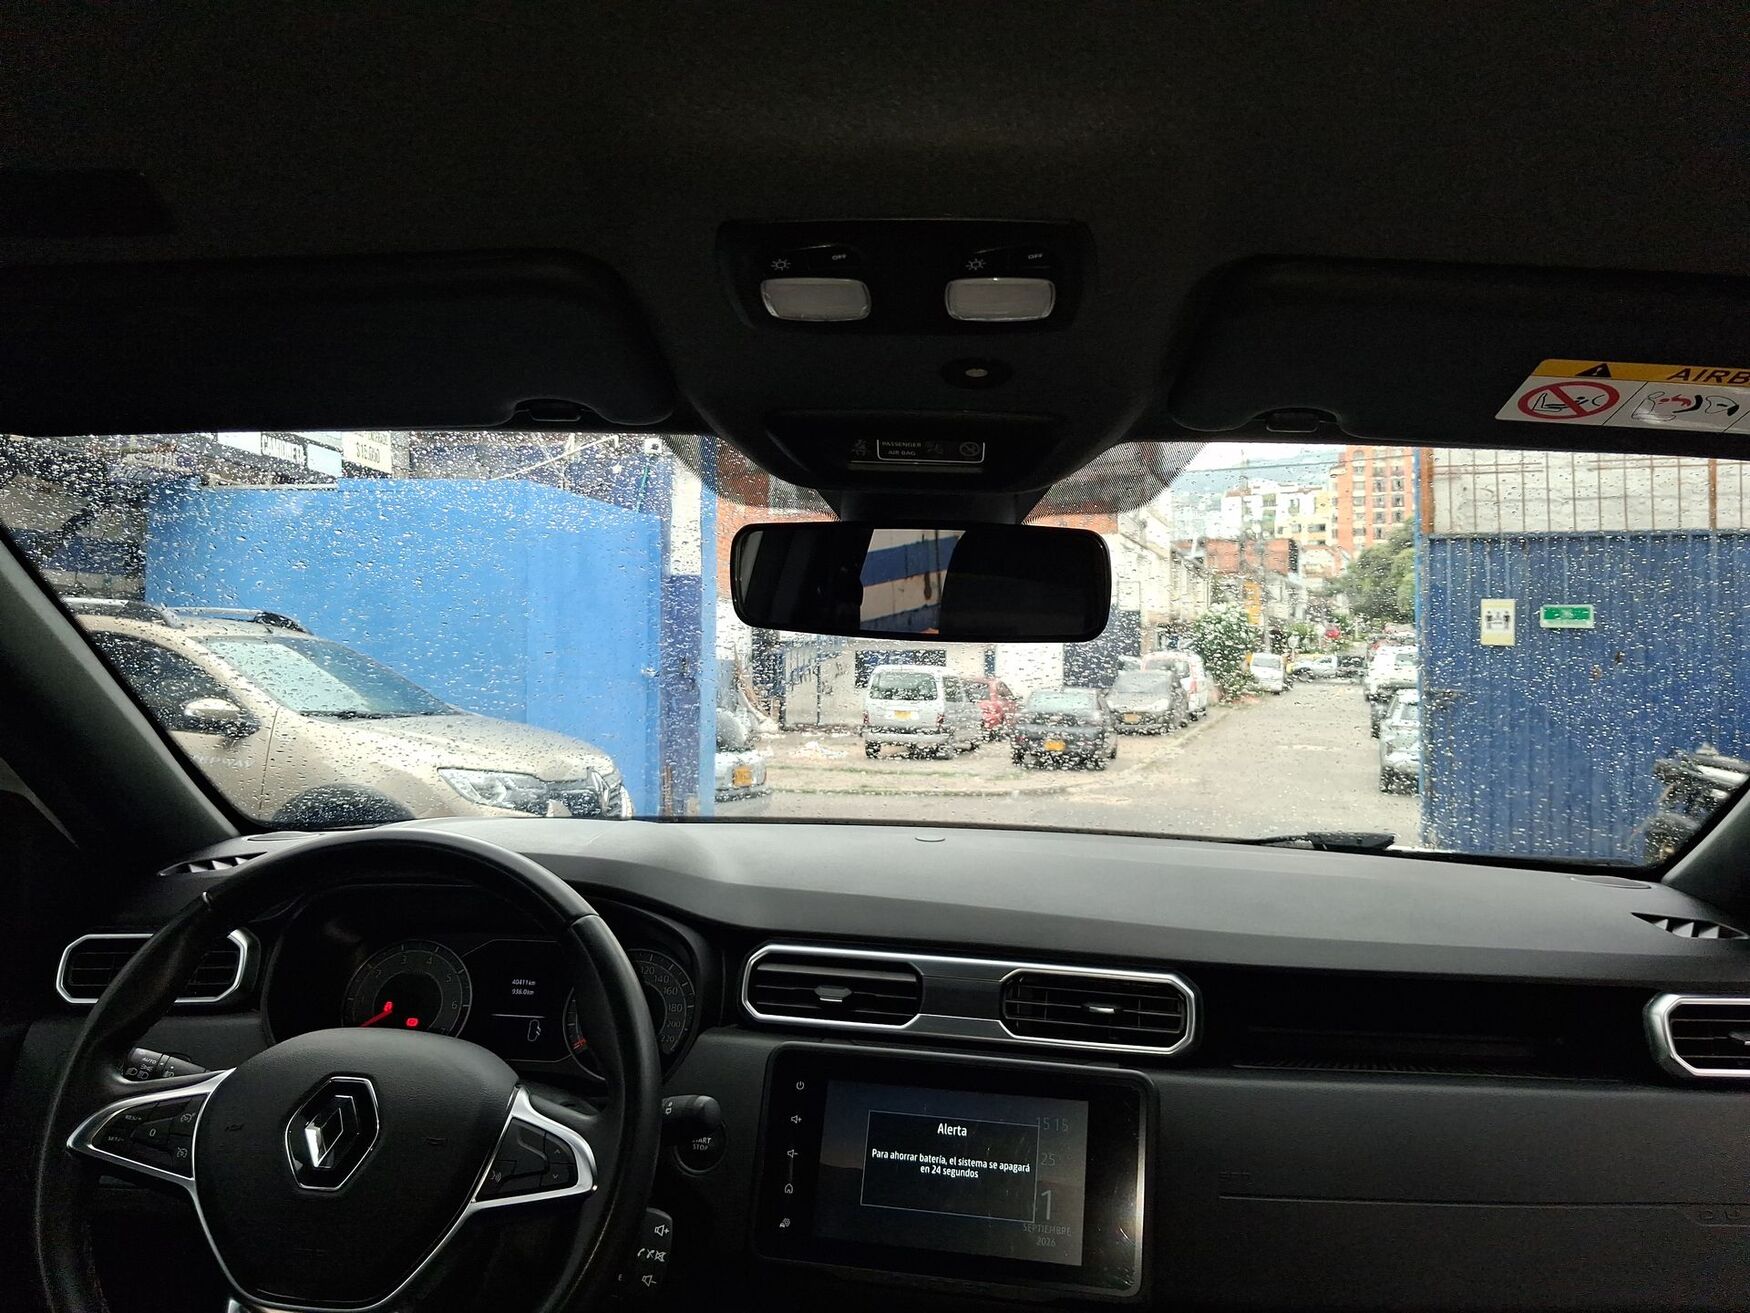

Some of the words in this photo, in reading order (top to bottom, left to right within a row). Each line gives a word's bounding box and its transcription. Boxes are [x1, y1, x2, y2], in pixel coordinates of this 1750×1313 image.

[668, 1003, 683, 1012] 180
[937, 1123, 968, 1137] Alerta
[872, 1149, 889, 1159] Para
[890, 1150, 917, 1162] ahorrar
[919, 1153, 948, 1166] batería,
[949, 1156, 957, 1165] el
[958, 1157, 987, 1168] sistema
[999, 1162, 1031, 1173] apagará
[1040, 1152, 1056, 1166] 25
[931, 1165, 941, 1174] 24
[942, 1167, 979, 1178] segundos
[1023, 1223, 1072, 1237] SEPTIEMBRE
